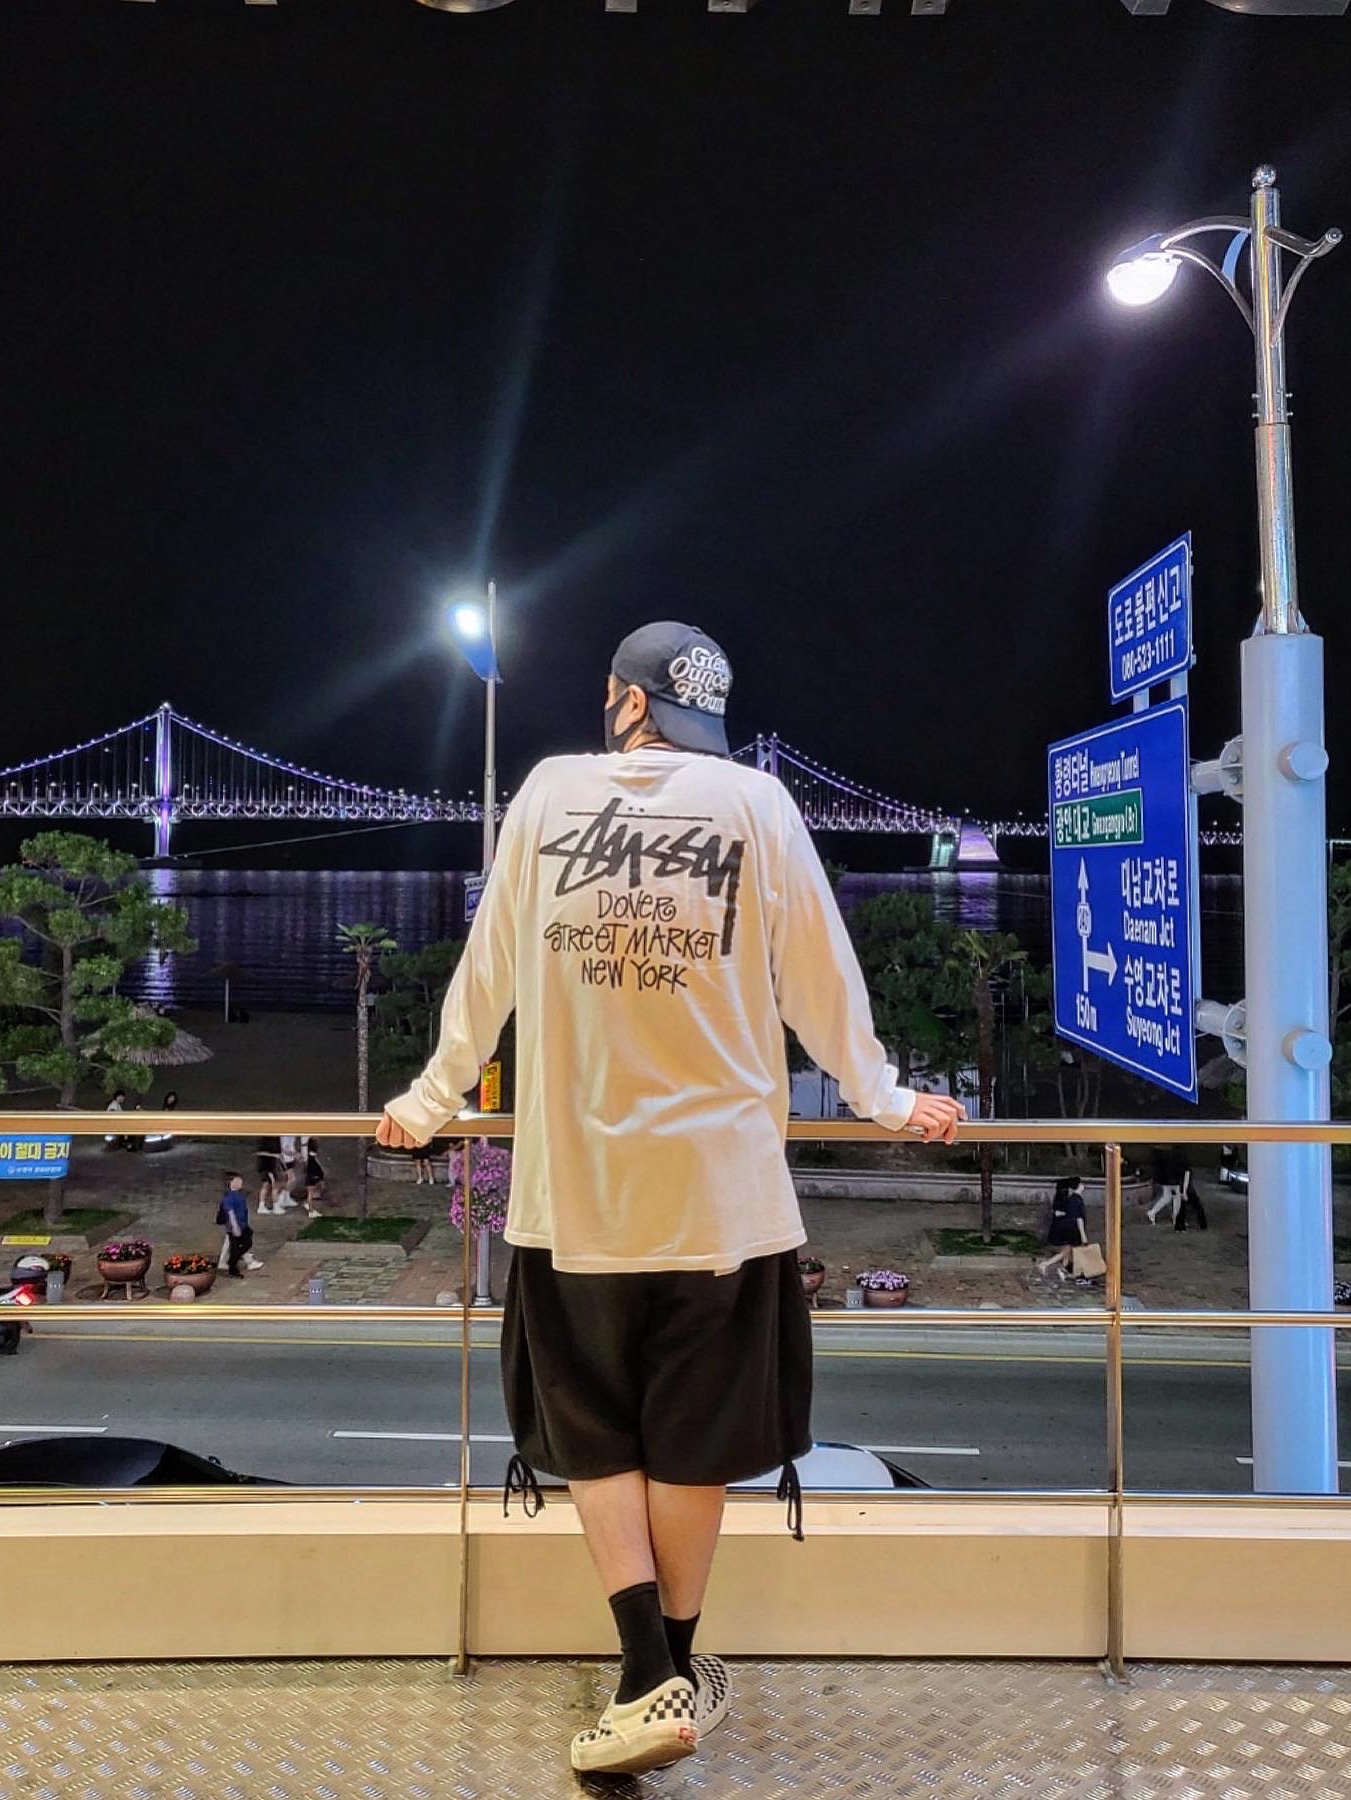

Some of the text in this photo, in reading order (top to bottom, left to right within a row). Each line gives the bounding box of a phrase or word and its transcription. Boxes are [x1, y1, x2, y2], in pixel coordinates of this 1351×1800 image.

[1055, 747, 1089, 799] 황령터널
[1056, 803, 1091, 844] 광안대교
[1121, 856, 1180, 911] 대남교차로
[1123, 909, 1158, 946] Daenam
[1159, 914, 1176, 949] Jct
[630, 957, 688, 995] YORK
[1124, 953, 1182, 1017] 수영교차로
[1076, 992, 1098, 1032] 150m
[1126, 1005, 1181, 1058] Suyeong Jct
[45, 1142, 70, 1160] 금지
